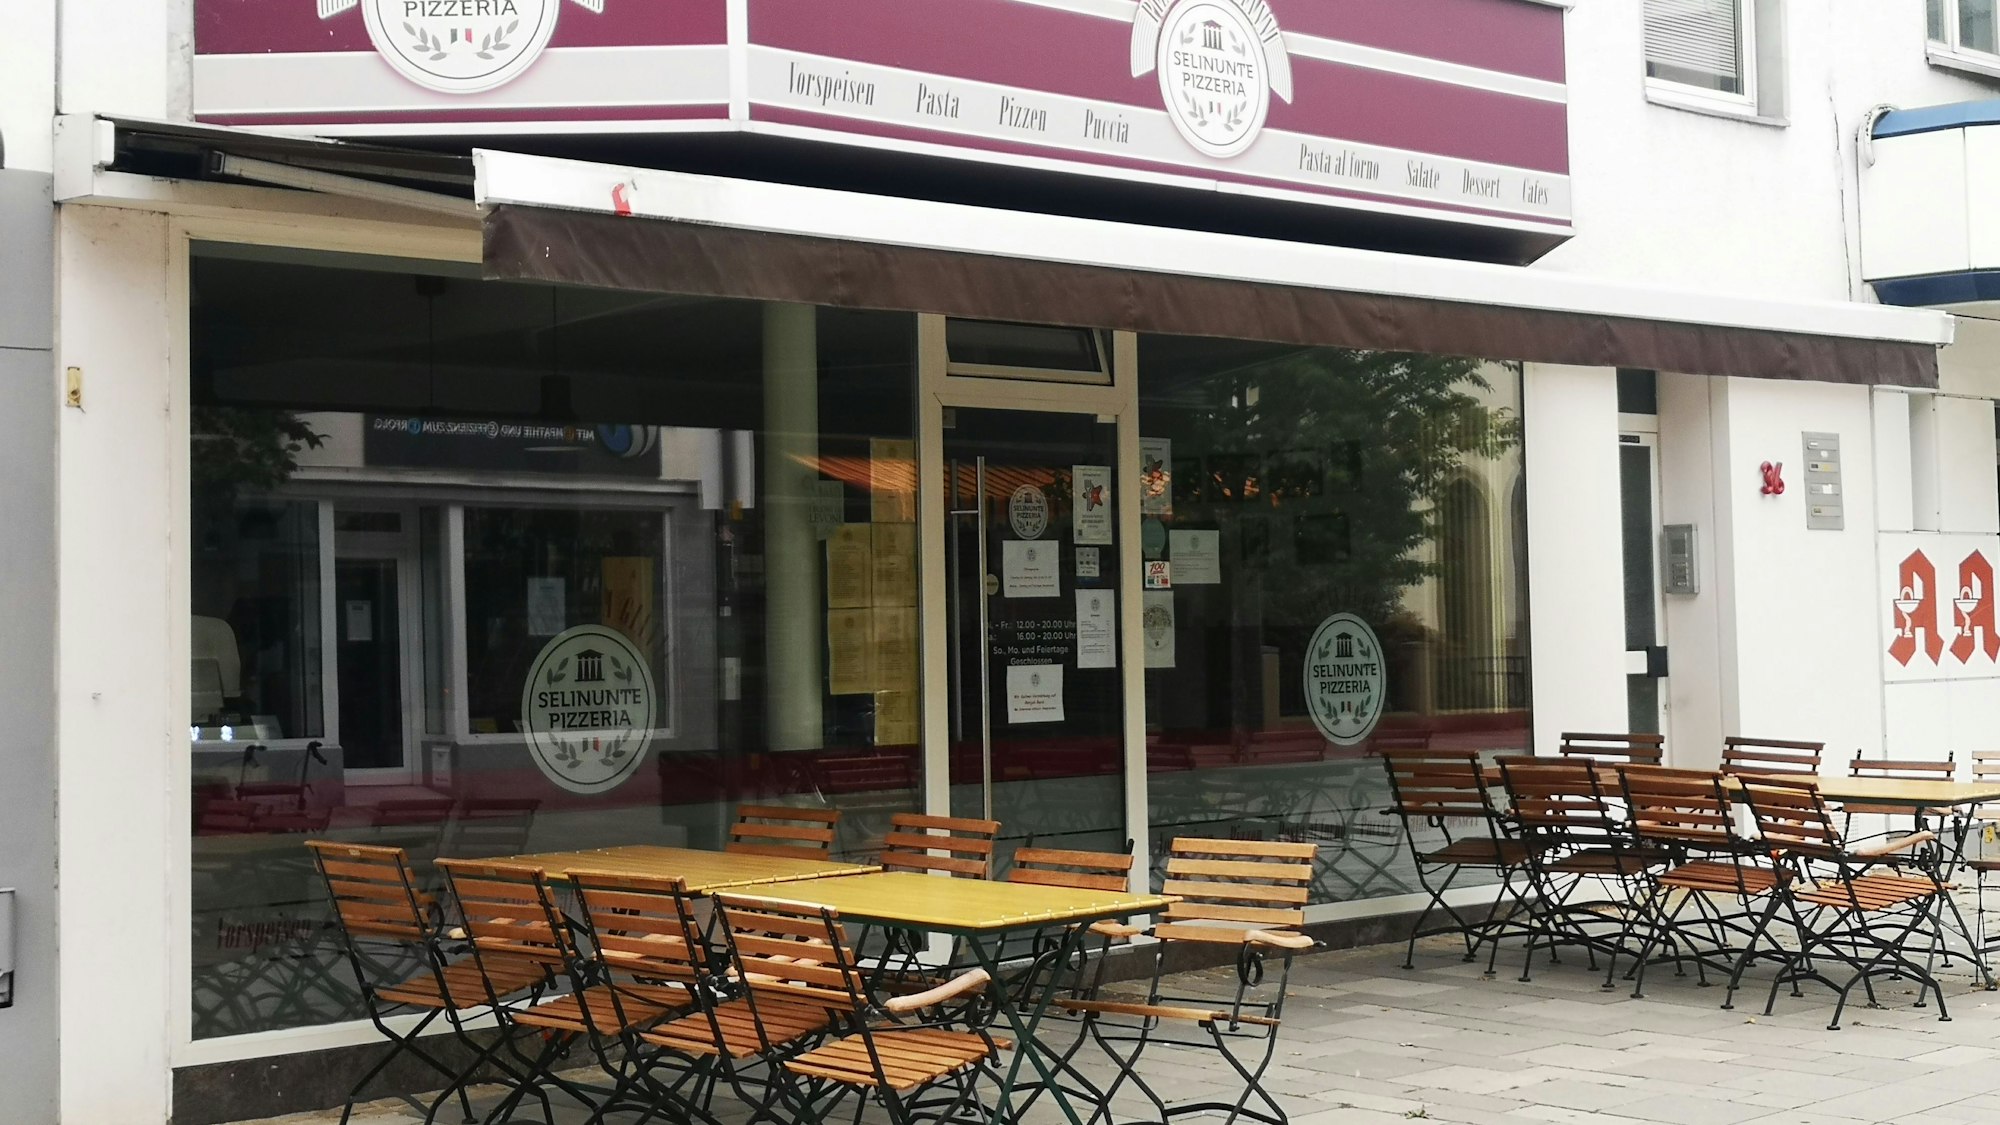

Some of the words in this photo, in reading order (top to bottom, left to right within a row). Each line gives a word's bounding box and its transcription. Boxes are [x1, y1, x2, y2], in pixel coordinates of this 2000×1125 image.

[404, 0, 519, 18] PIZZERIA
[1173, 50, 1254, 79] SELINUNTE
[1182, 71, 1247, 97] PIZZERIA
[788, 61, 876, 106] Vorspeisen
[915, 82, 960, 119] Pasta
[999, 95, 1047, 132] Pizzen
[1083, 108, 1130, 143] Puccia
[1299, 142, 1331, 174] Pasta
[1334, 149, 1346, 177] al
[1349, 151, 1380, 180] forno
[1405, 159, 1440, 190] Salate
[1462, 167, 1500, 199] Dessert
[1016, 620, 1035, 629] 12.00
[1042, 620, 1063, 629] 20.00
[1016, 632, 1036, 640] 16.00
[1042, 631, 1063, 640] 20.00
[1064, 631, 1076, 640] Uhr
[1007, 646, 1020, 654] Mo.
[1021, 645, 1035, 654] und
[1036, 645, 1069, 655] Feiertage
[1010, 657, 1053, 666] Geschlossen
[1313, 663, 1377, 678] SELINUNTE
[1319, 680, 1371, 695] PIZZERIA
[538, 688, 642, 709] SELINUNTE
[549, 709, 632, 729] PIZZERIA
